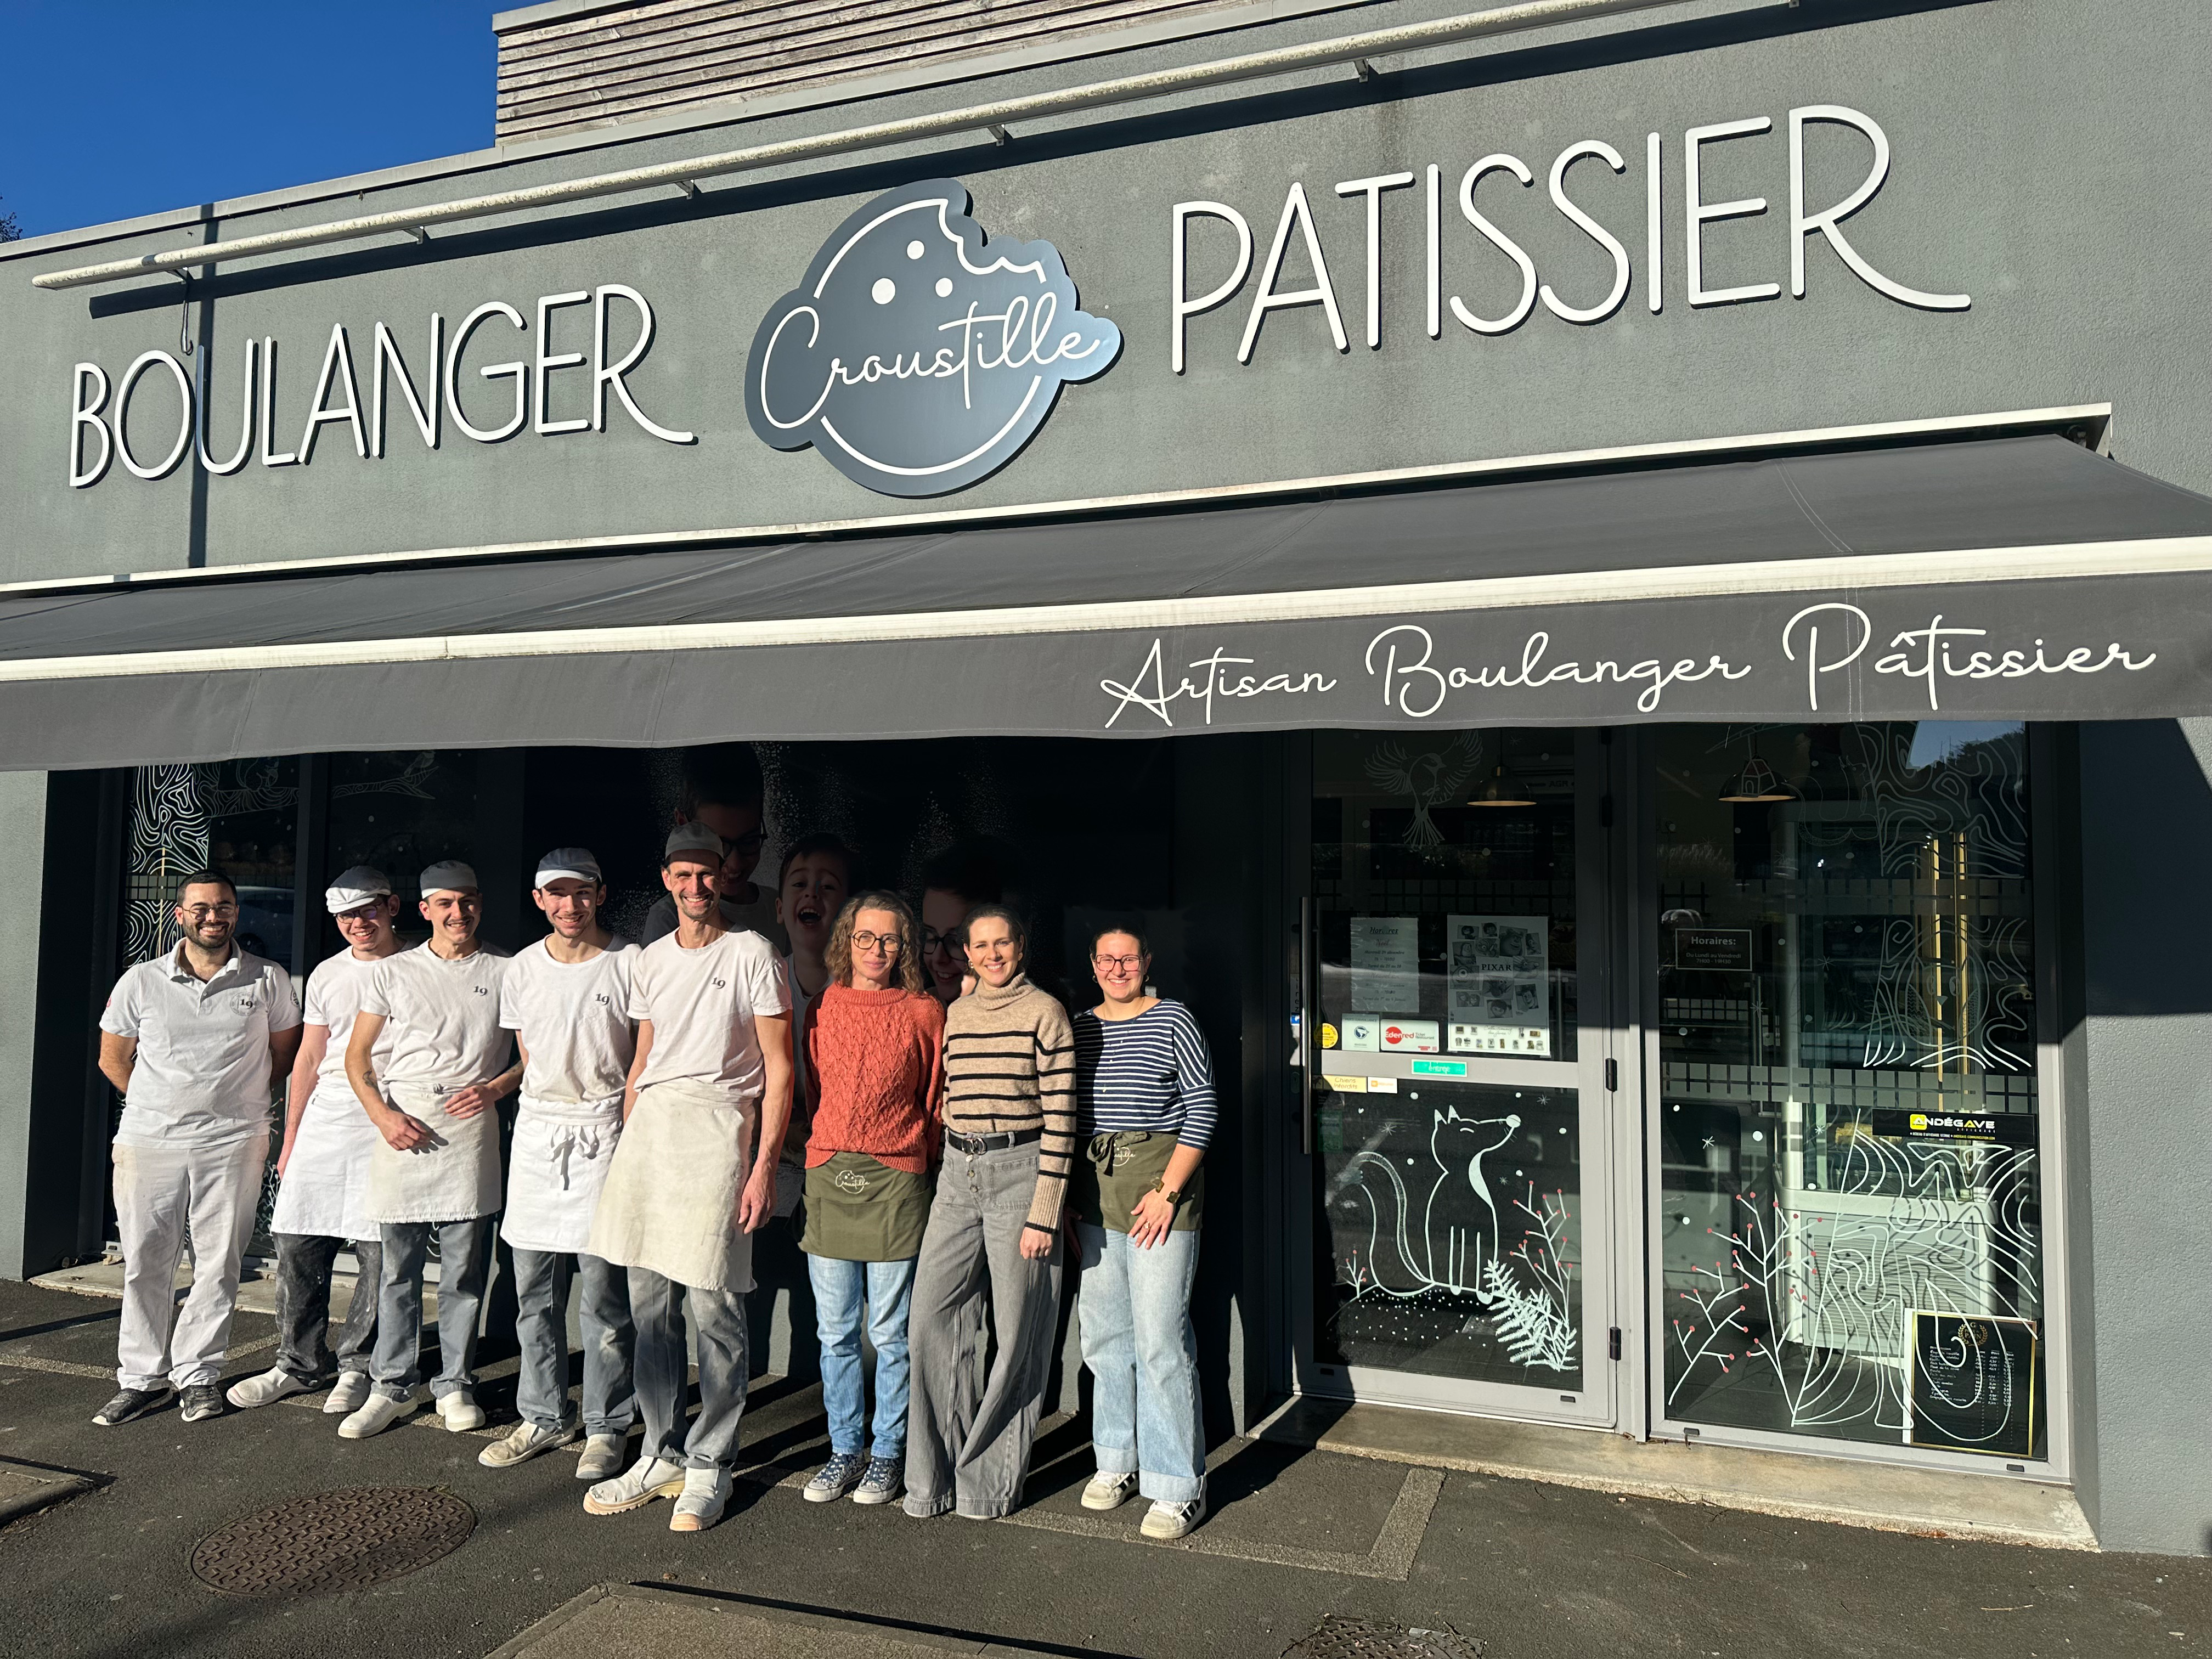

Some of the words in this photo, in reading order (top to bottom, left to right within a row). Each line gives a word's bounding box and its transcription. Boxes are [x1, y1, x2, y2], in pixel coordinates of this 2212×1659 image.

[69, 284, 693, 487] BOULANGER
[1172, 104, 1971, 373] PATISSIER
[760, 292, 1100, 428] Croustille
[1100, 639, 1337, 727] Artisan
[1365, 625, 1752, 717] Boulanger
[1782, 603, 2157, 711] Pâtissier
[1691, 936, 1736, 945] Horaires:
[711, 977, 726, 989] 19
[474, 985, 488, 996] 19
[240, 999, 253, 1009] 19
[595, 993, 610, 1006] 19
[1913, 1117, 1995, 1129] ANDÉGAVE
